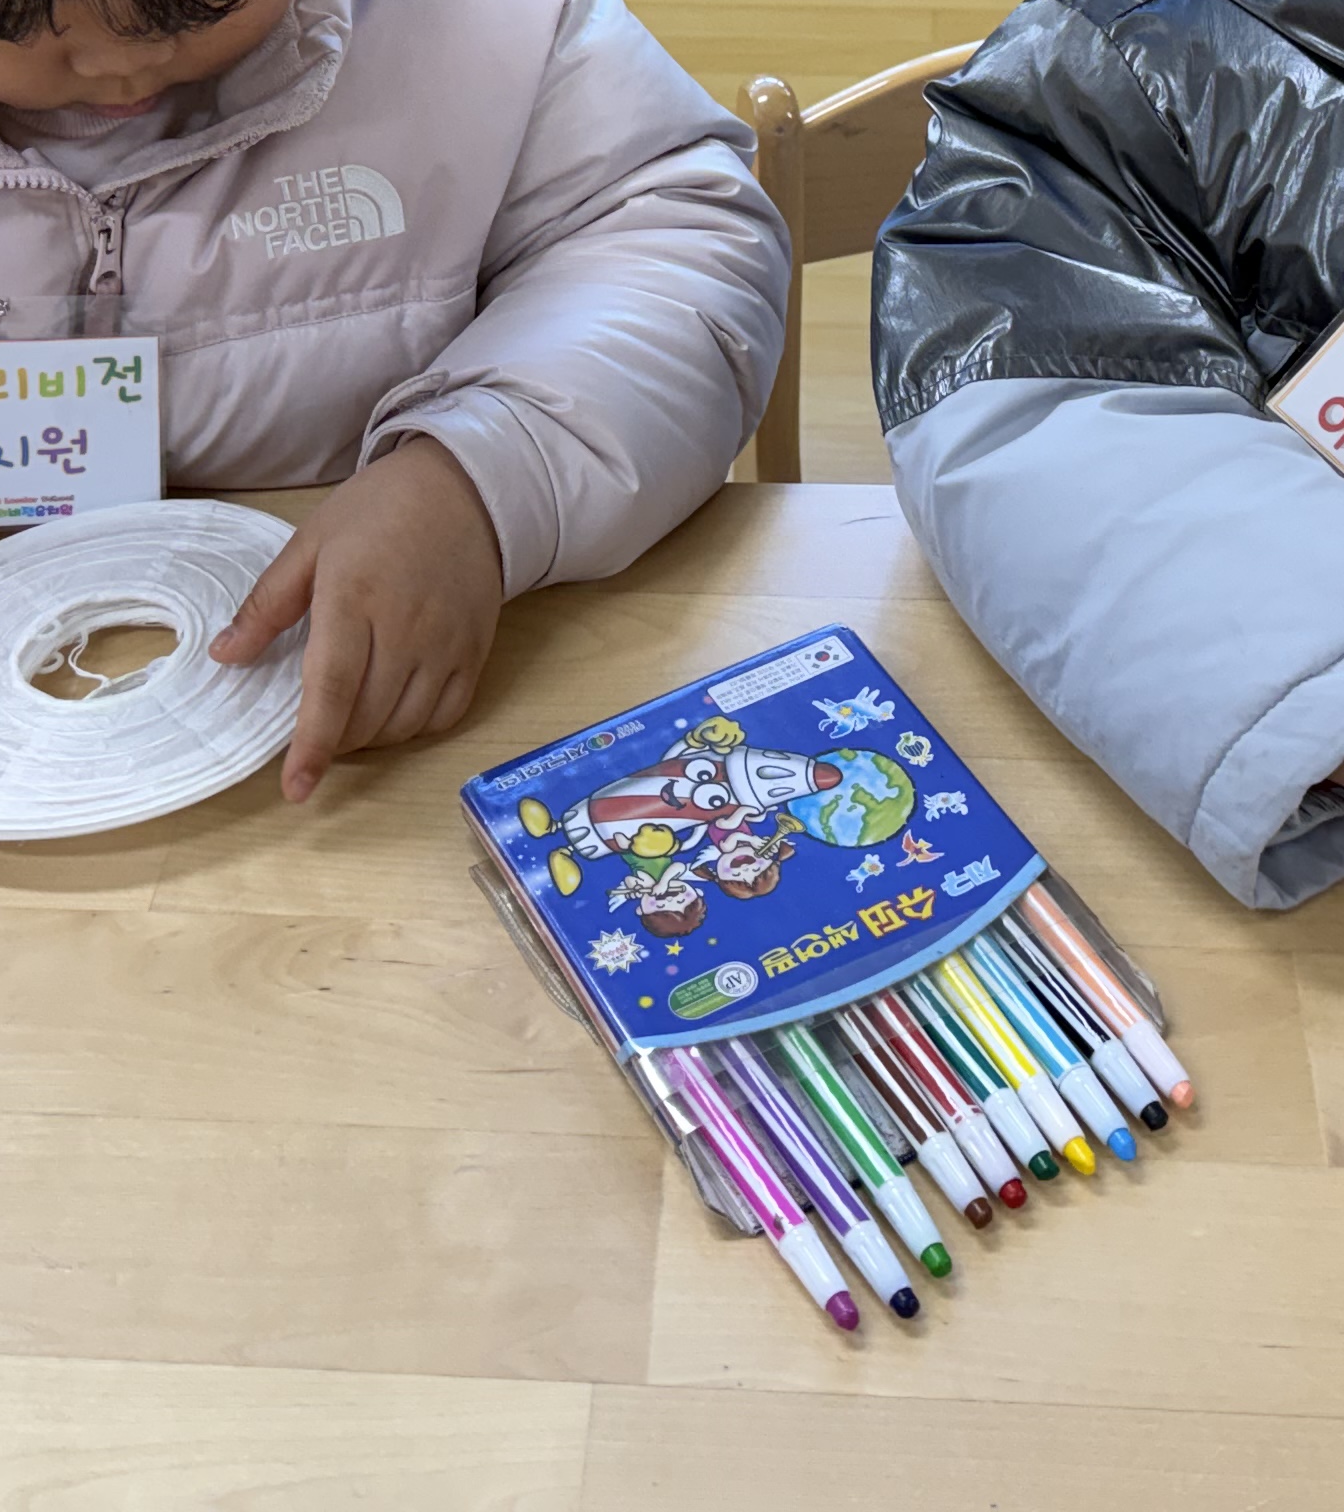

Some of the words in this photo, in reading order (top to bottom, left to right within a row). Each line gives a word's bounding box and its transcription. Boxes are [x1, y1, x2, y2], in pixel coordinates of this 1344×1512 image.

[273, 166, 344, 202] THE
[229, 192, 347, 240] NORTH
[264, 219, 350, 260] FACE
[940, 854, 1002, 897] 지구
[856, 885, 937, 939] 슈퍼
[758, 920, 860, 979] 색연필
[725, 968, 743, 990] AP
